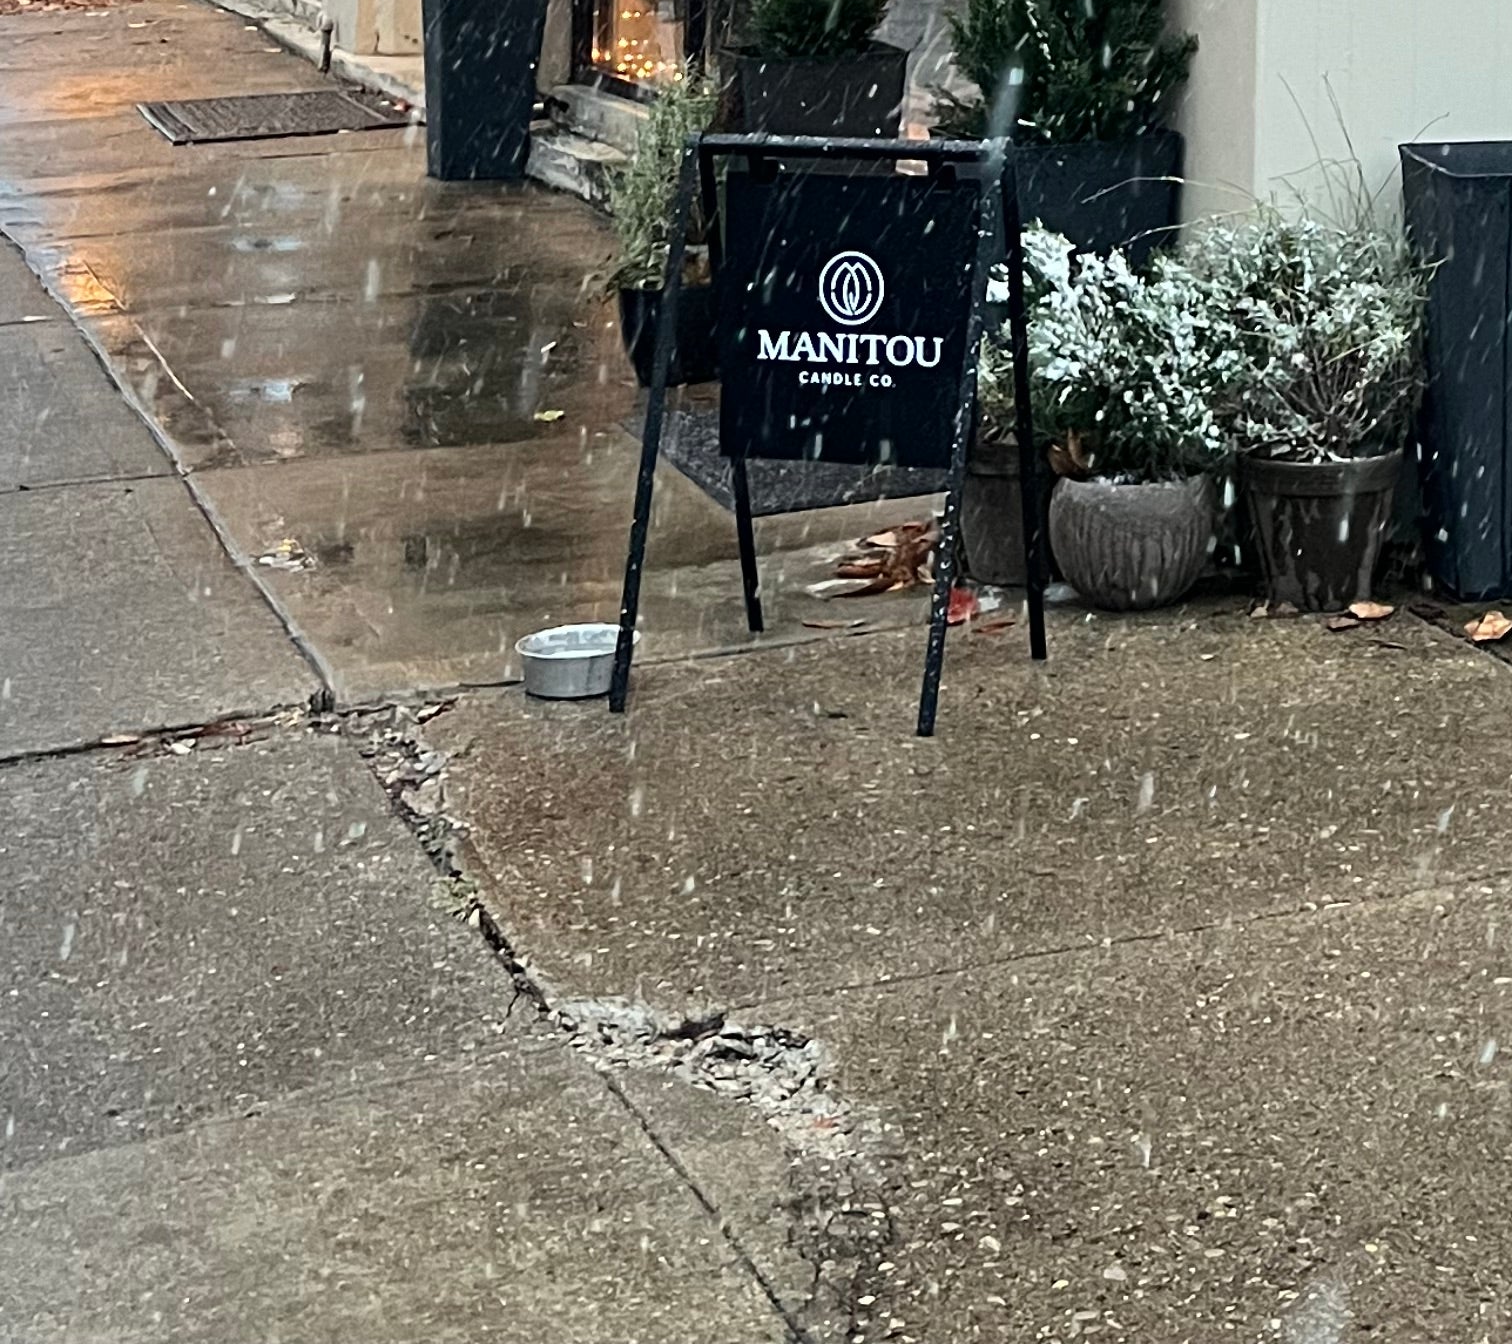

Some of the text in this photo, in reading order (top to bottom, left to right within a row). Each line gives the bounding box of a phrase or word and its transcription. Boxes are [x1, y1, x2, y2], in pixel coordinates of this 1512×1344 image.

[757, 329, 943, 367] MANITOU
[799, 371, 896, 388] CANDLE CO.
